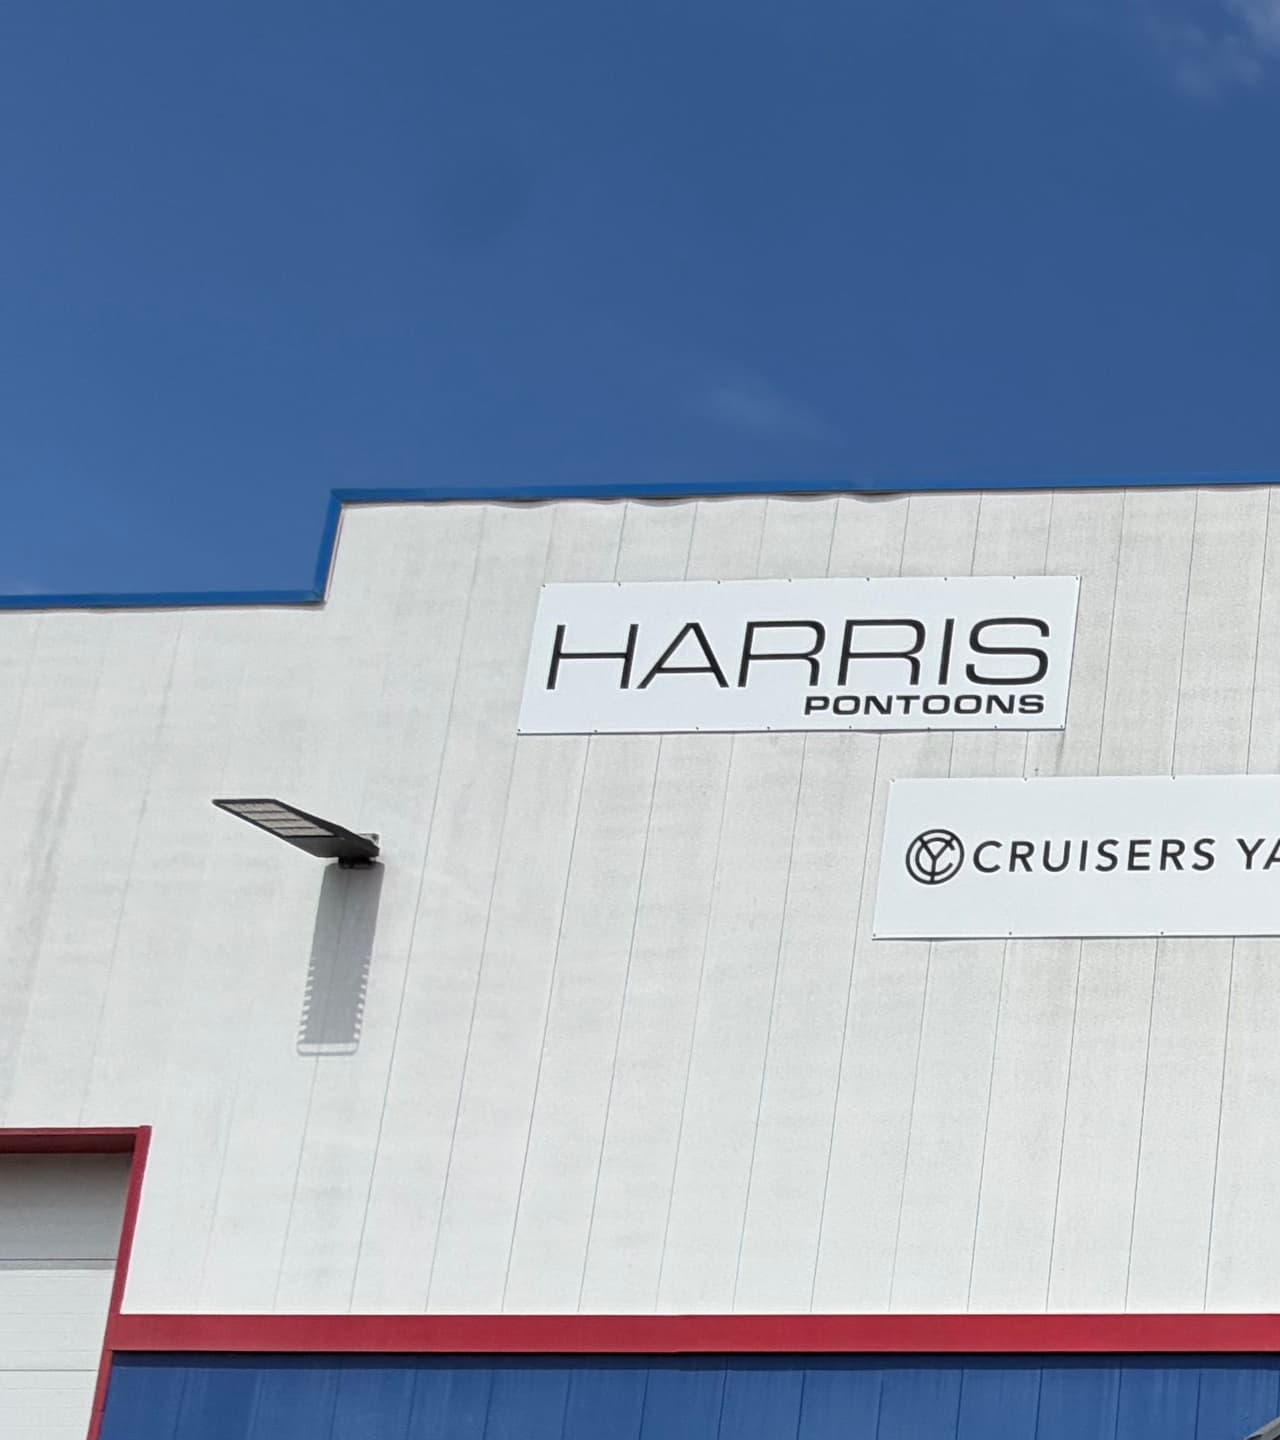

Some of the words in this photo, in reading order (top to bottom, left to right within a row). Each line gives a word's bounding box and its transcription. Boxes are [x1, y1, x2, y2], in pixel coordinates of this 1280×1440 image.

[547, 618, 1049, 689] HARRIS
[805, 695, 1043, 714] PONTOONS
[974, 839, 1214, 872] CRUISERS
